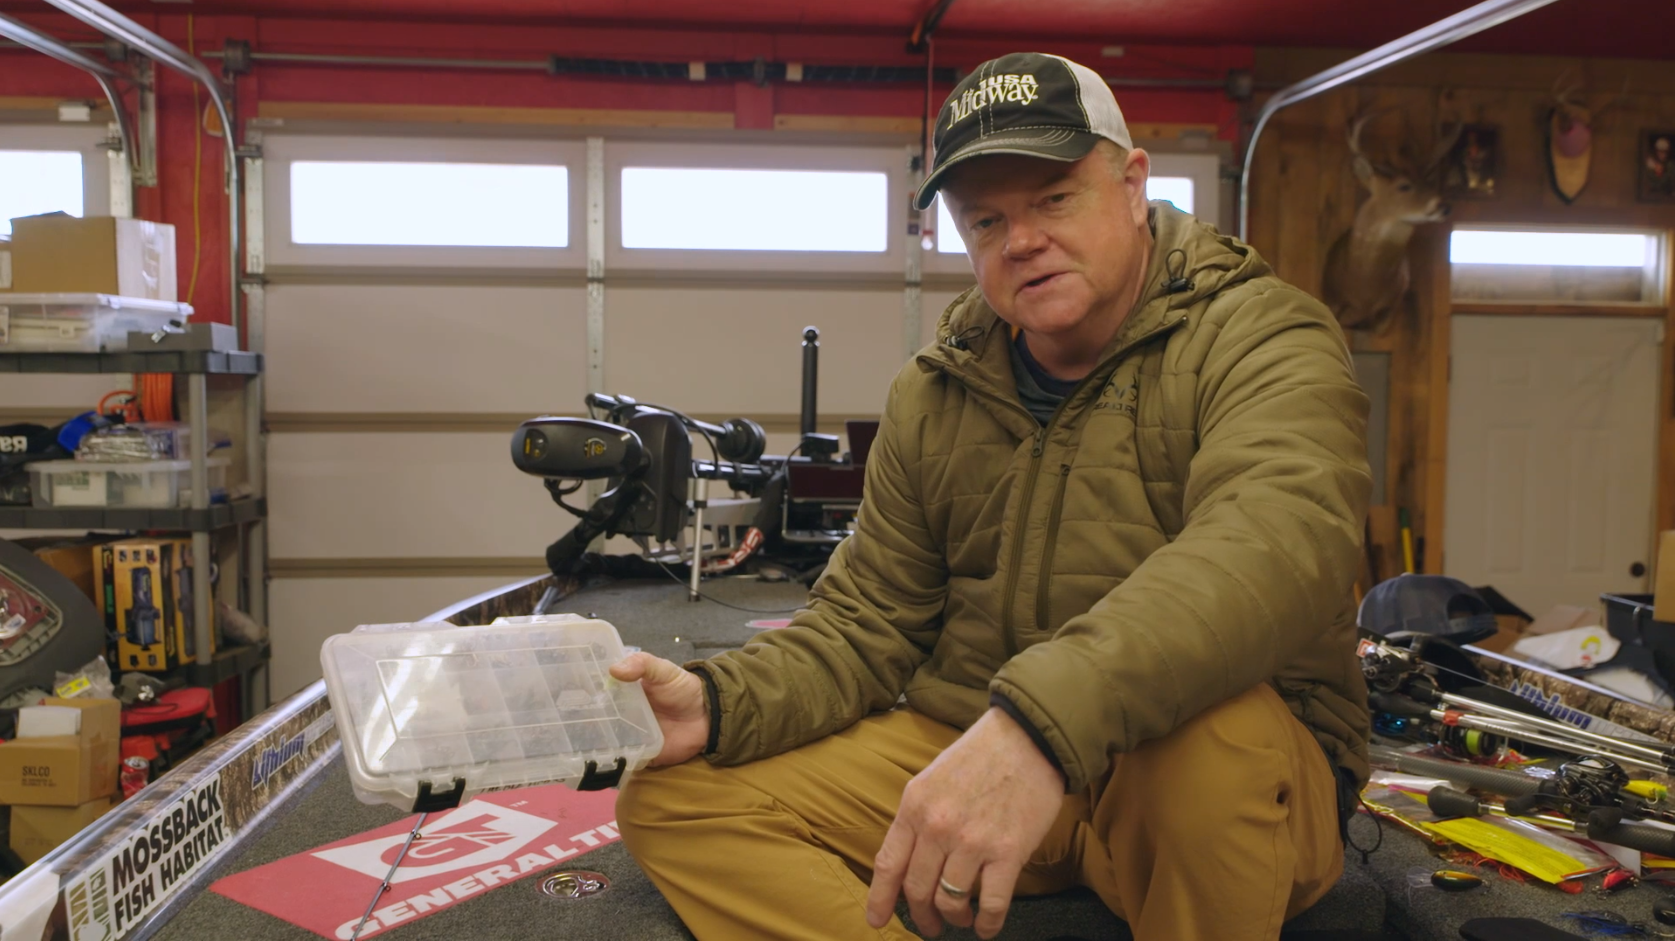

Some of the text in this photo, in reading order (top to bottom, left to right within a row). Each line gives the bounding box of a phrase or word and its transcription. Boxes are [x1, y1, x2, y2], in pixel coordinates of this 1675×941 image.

[947, 79, 1039, 131] Midway
[988, 74, 1037, 85] USA
[112, 778, 221, 897] MOSSBACK
[114, 815, 225, 932] FISH HABITAT
[335, 843, 579, 940] GENERAL
